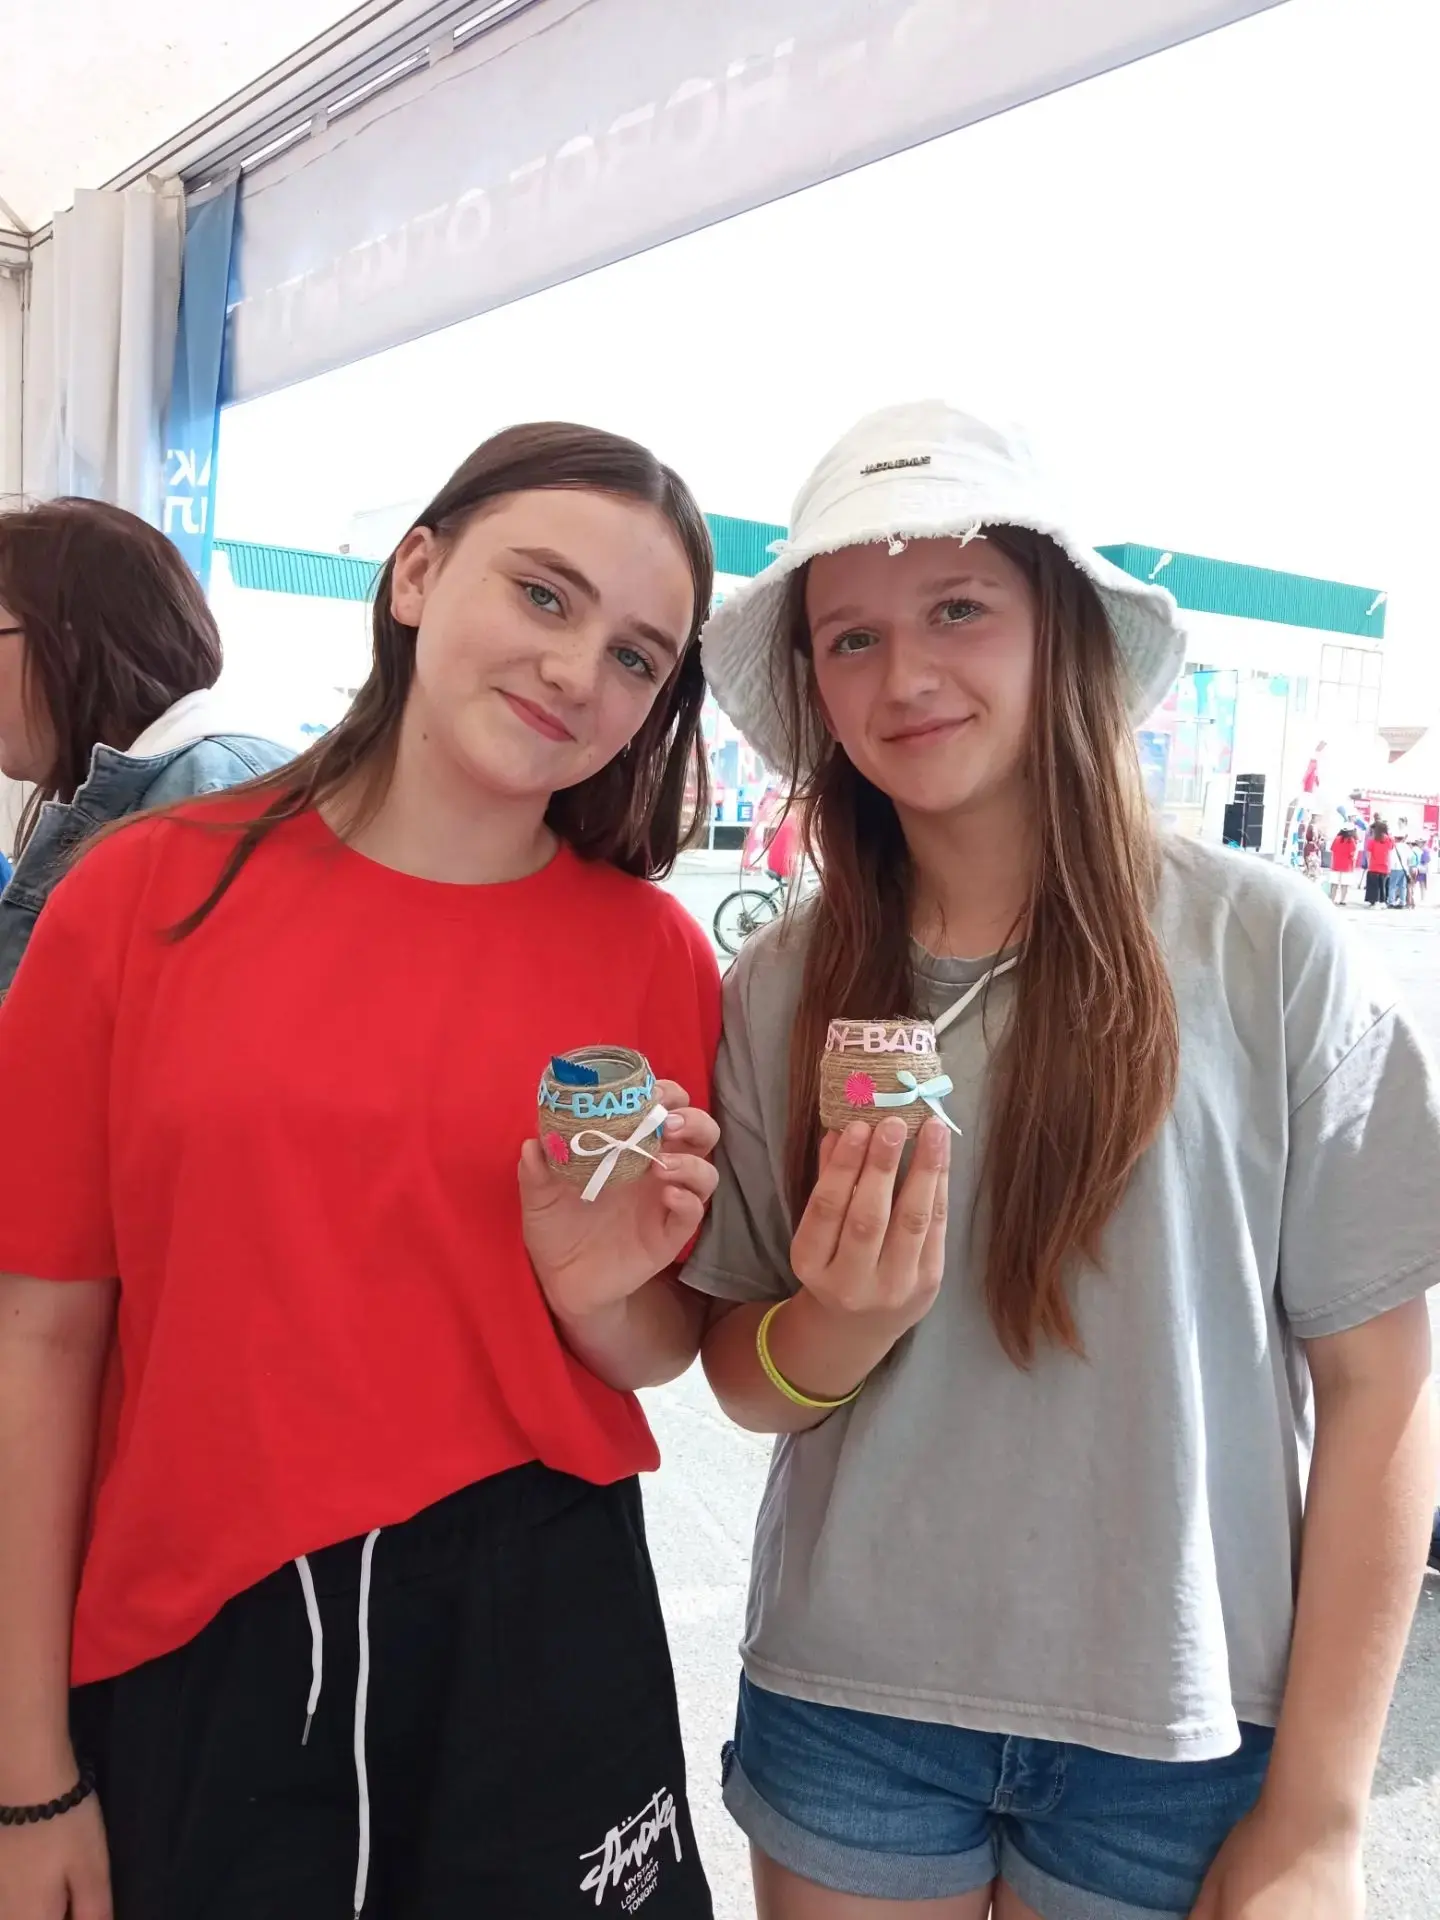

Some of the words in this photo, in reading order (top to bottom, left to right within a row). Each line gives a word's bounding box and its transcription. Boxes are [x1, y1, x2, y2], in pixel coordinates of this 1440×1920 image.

[621, 1884, 640, 1910] LOST
[640, 1861, 659, 1889] LIGHT
[627, 1877, 658, 1915] TONIGHT
